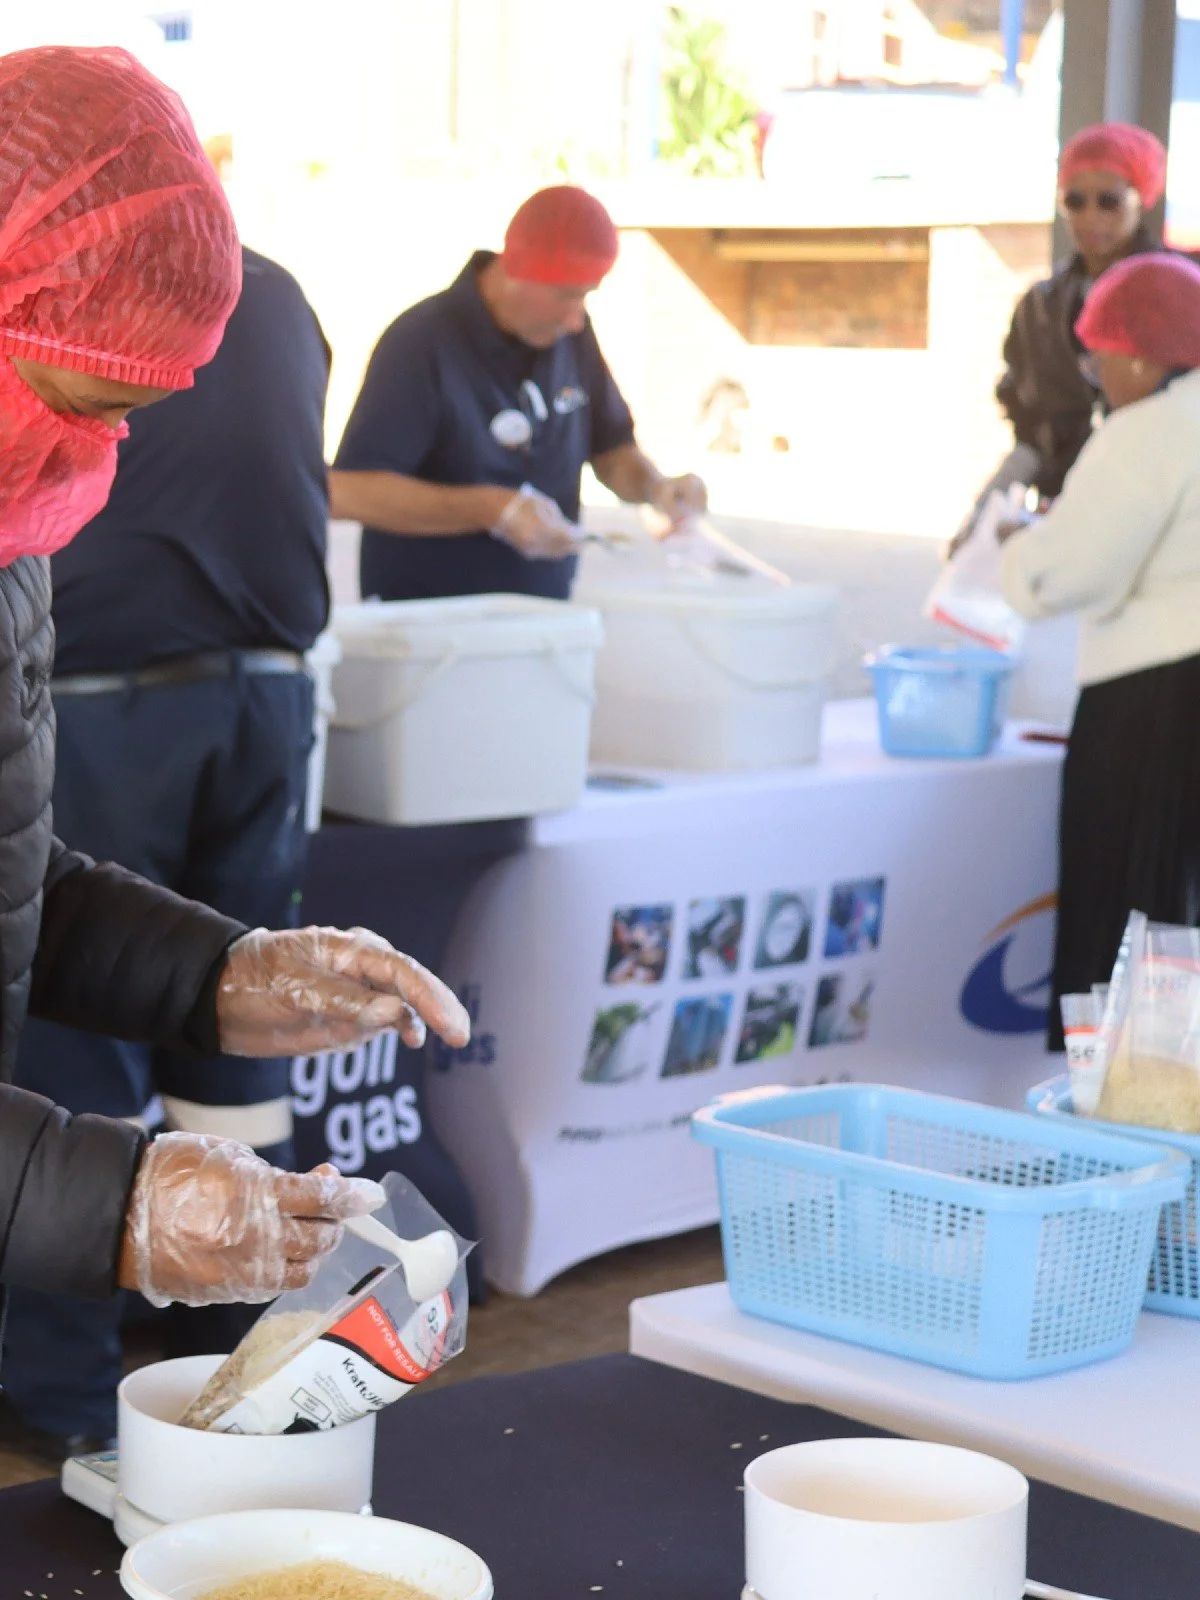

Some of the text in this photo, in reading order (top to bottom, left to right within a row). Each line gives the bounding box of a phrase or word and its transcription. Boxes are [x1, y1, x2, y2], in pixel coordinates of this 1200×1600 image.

[325, 1085, 423, 1174] gas
[367, 1305, 424, 1378] NOT FOR RESALE
